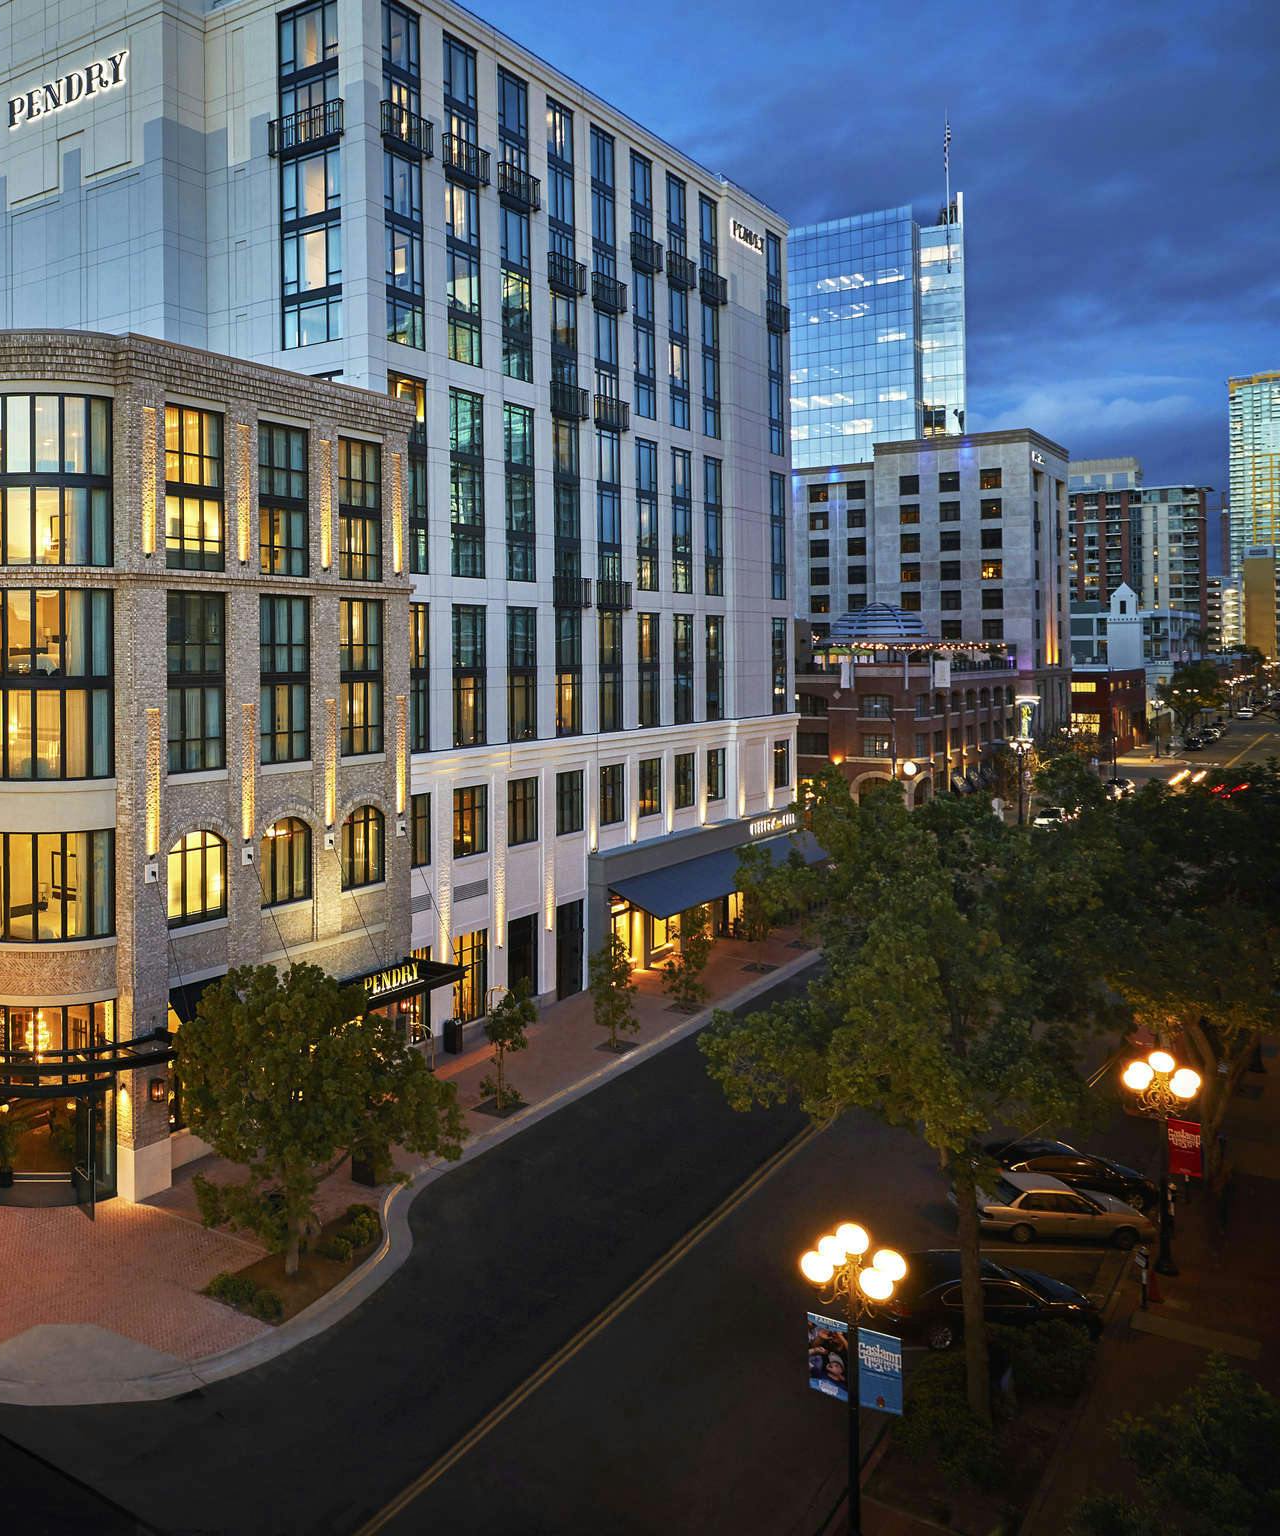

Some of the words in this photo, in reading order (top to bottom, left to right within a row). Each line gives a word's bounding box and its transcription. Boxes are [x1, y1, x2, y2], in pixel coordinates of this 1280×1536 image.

[7, 51, 128, 128] PENDRY
[364, 962, 420, 994] PENDRY
[858, 1342, 902, 1369] Gaslamp
